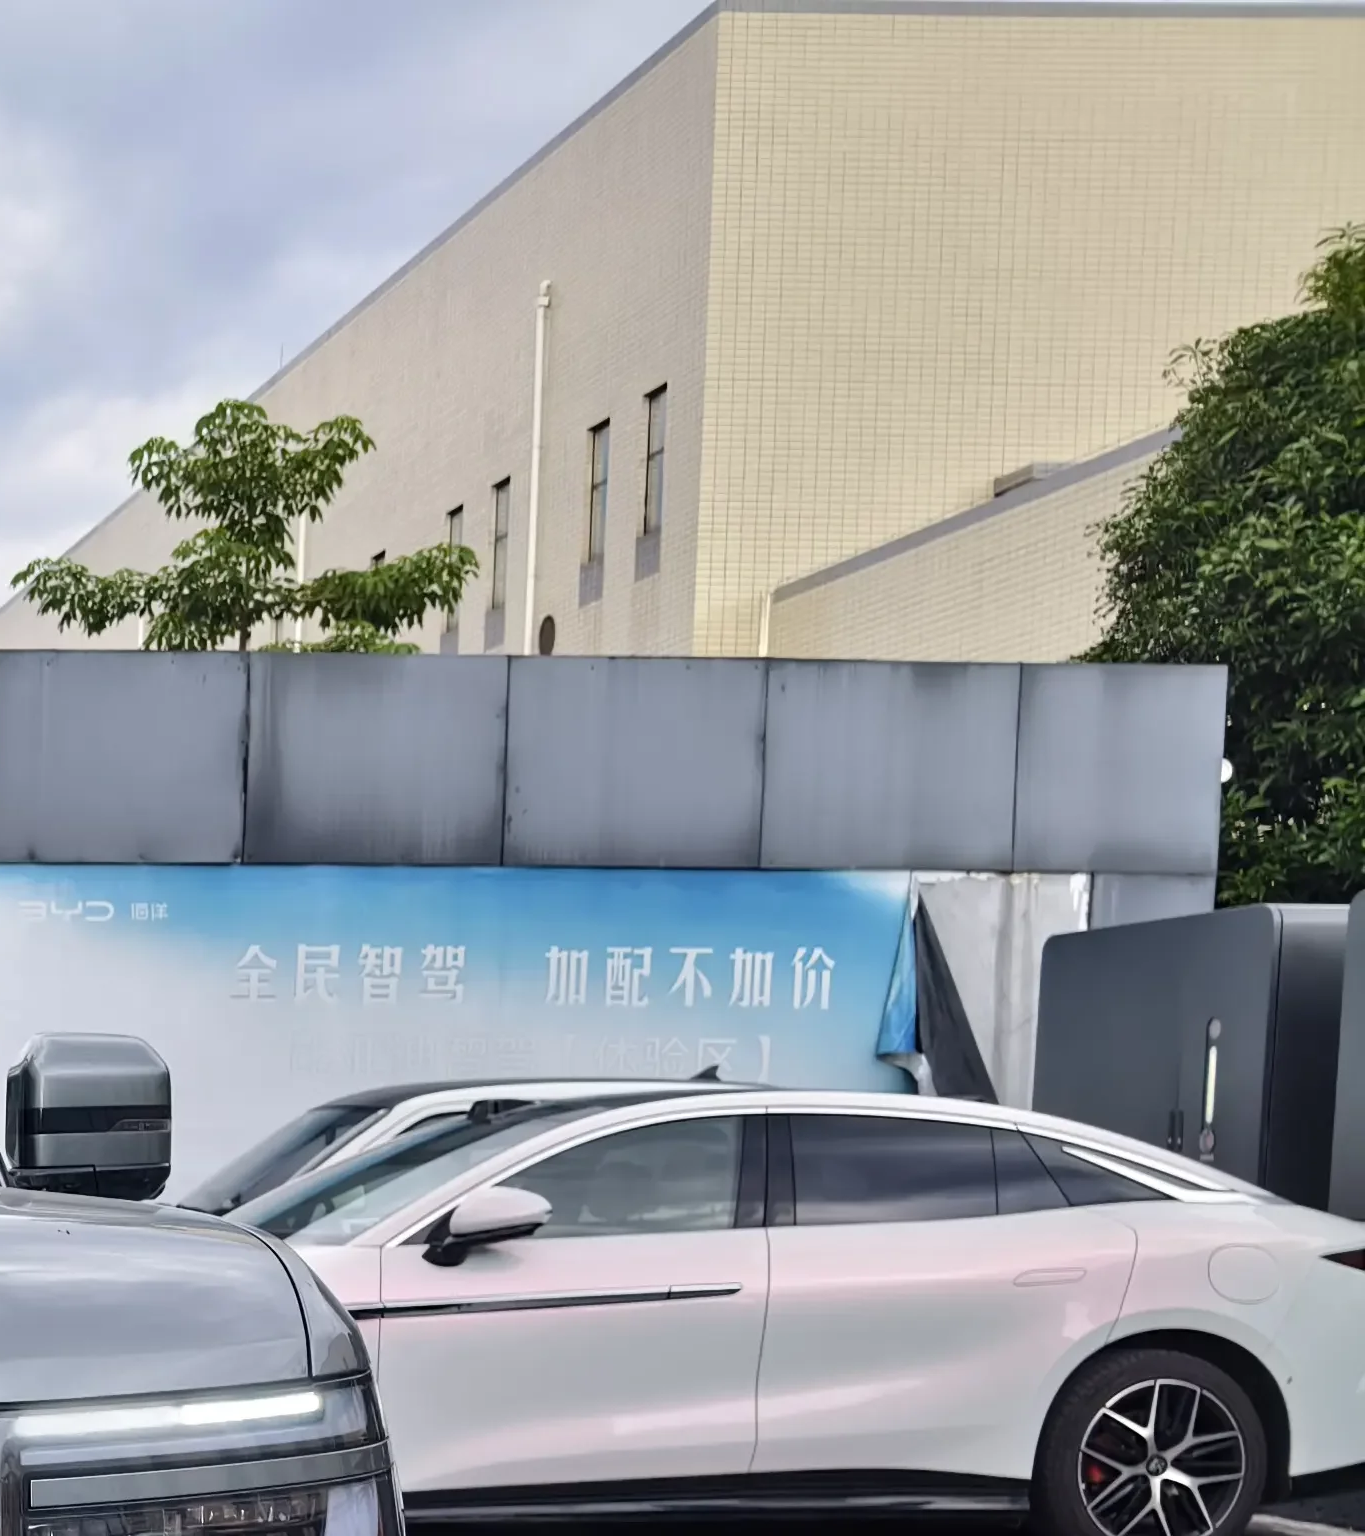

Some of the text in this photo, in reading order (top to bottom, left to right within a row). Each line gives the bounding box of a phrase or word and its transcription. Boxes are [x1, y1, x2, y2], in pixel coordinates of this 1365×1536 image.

[18, 900, 115, 922] BYD
[230, 943, 835, 1010] 全民智驾 加配不加价
